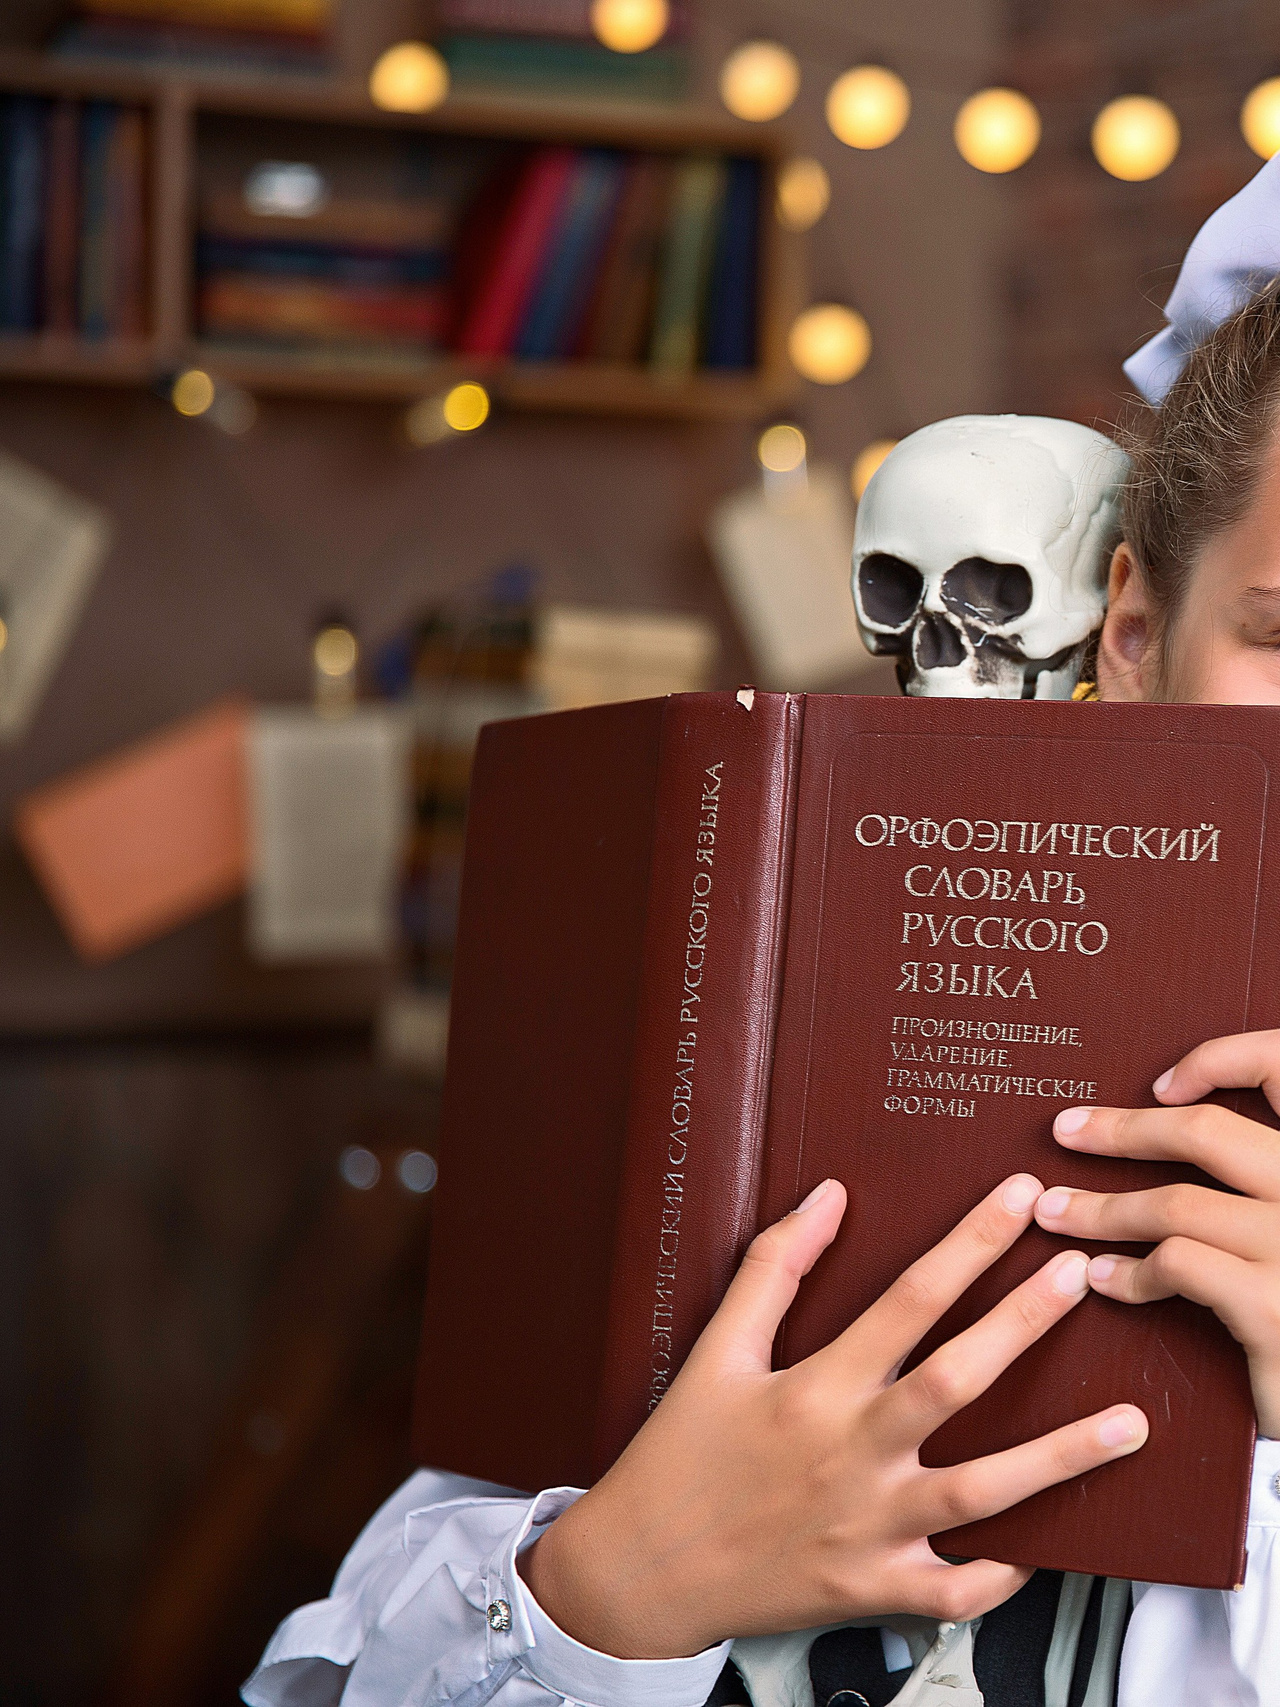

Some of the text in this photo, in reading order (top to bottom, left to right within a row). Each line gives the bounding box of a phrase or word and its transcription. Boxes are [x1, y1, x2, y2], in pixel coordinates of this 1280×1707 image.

[855, 814, 1221, 862] ОРФОЭПИЧЕСКИЙ
[904, 865, 1086, 905] СЛОВАРЬ
[900, 912, 1109, 955] РУССКОГО
[896, 962, 1039, 1000] ЯЗЫКА
[891, 1016, 1083, 1048] ПРОИЗНОШЕНИЕ,
[649, 761, 724, 1411] ФОЭПИЧЕСКИЙ СЛОВАРЬ РУССКОГО ЯЗЫКА
[887, 1068, 1098, 1100] ГРАММАТИЧЕСКИЕ
[883, 1094, 976, 1118] ФОРМЫ
